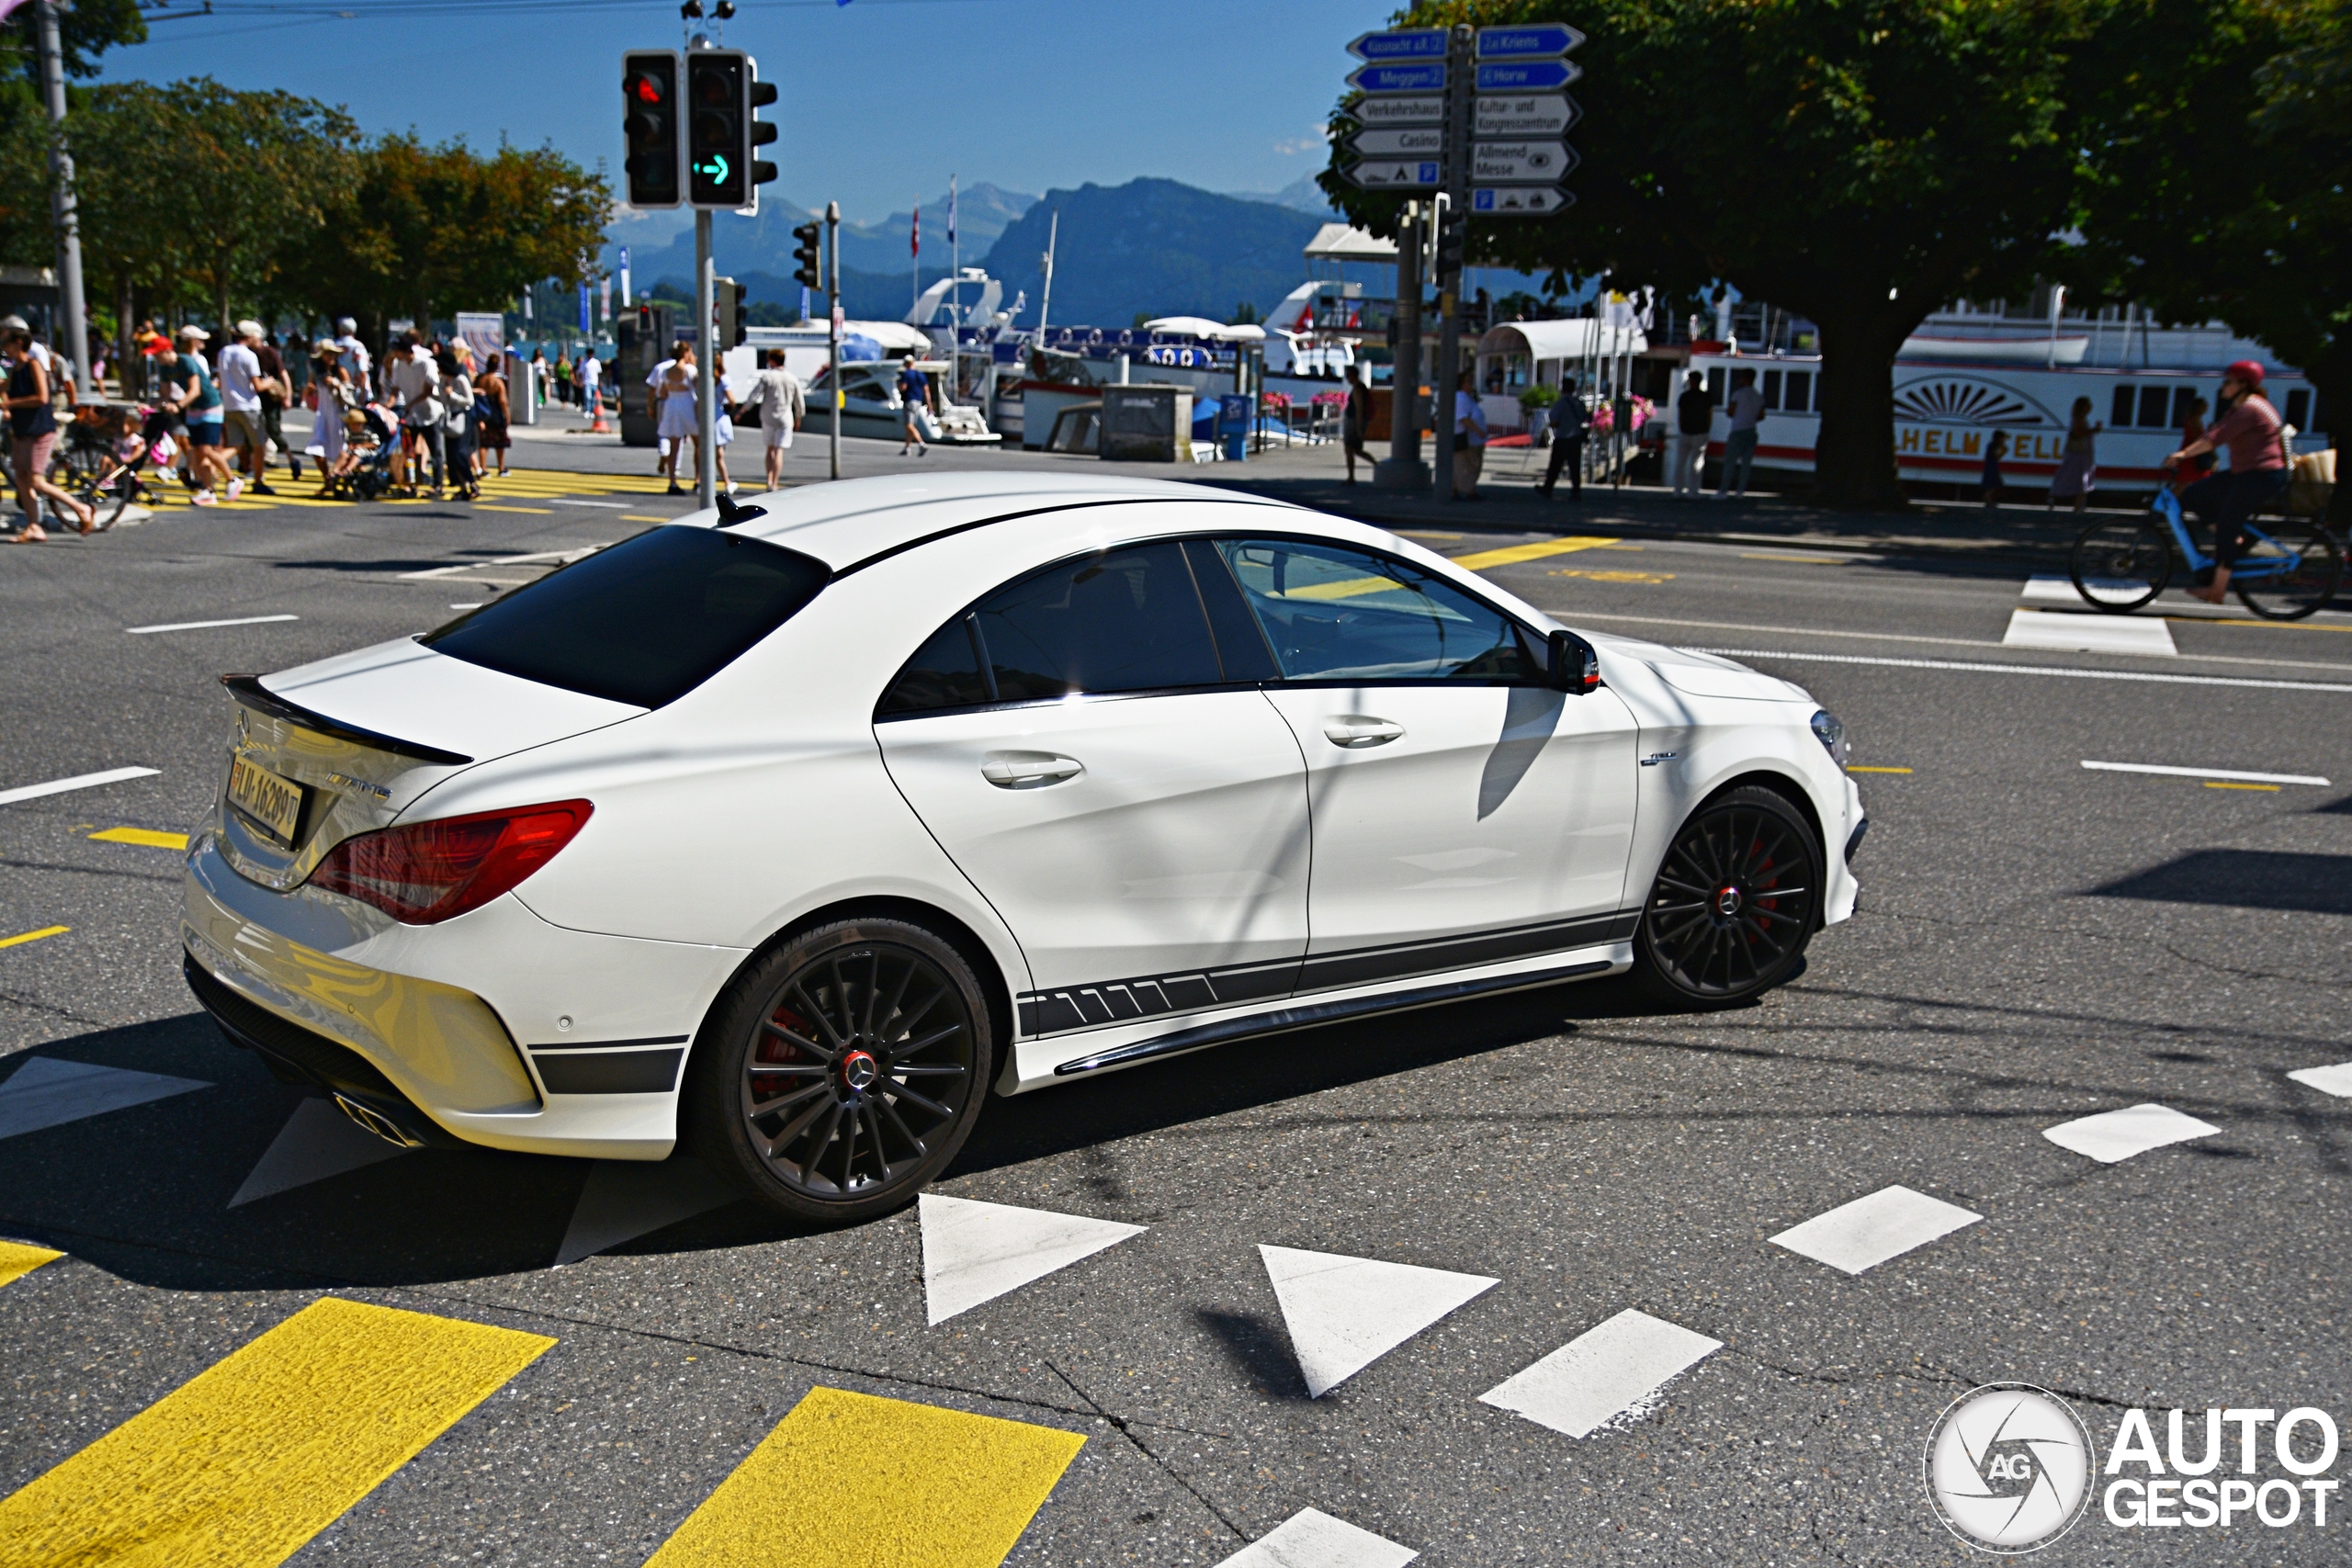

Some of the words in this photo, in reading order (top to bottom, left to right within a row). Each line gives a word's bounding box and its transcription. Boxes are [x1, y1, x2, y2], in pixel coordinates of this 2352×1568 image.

[1501, 35, 1540, 50] Kriens
[1379, 71, 1429, 88] Meggen
[1494, 70, 1528, 83] Horw
[1366, 101, 1441, 117] Verkehrshaus
[1478, 100, 1511, 113] Kultur-
[1515, 98, 1535, 112] und
[1477, 118, 1560, 134] Kongresszentrum
[1399, 133, 1440, 147] Casino
[1476, 144, 1527, 159] Allmend
[1476, 162, 1514, 175] Messe
[1894, 428, 1981, 455] HELM
